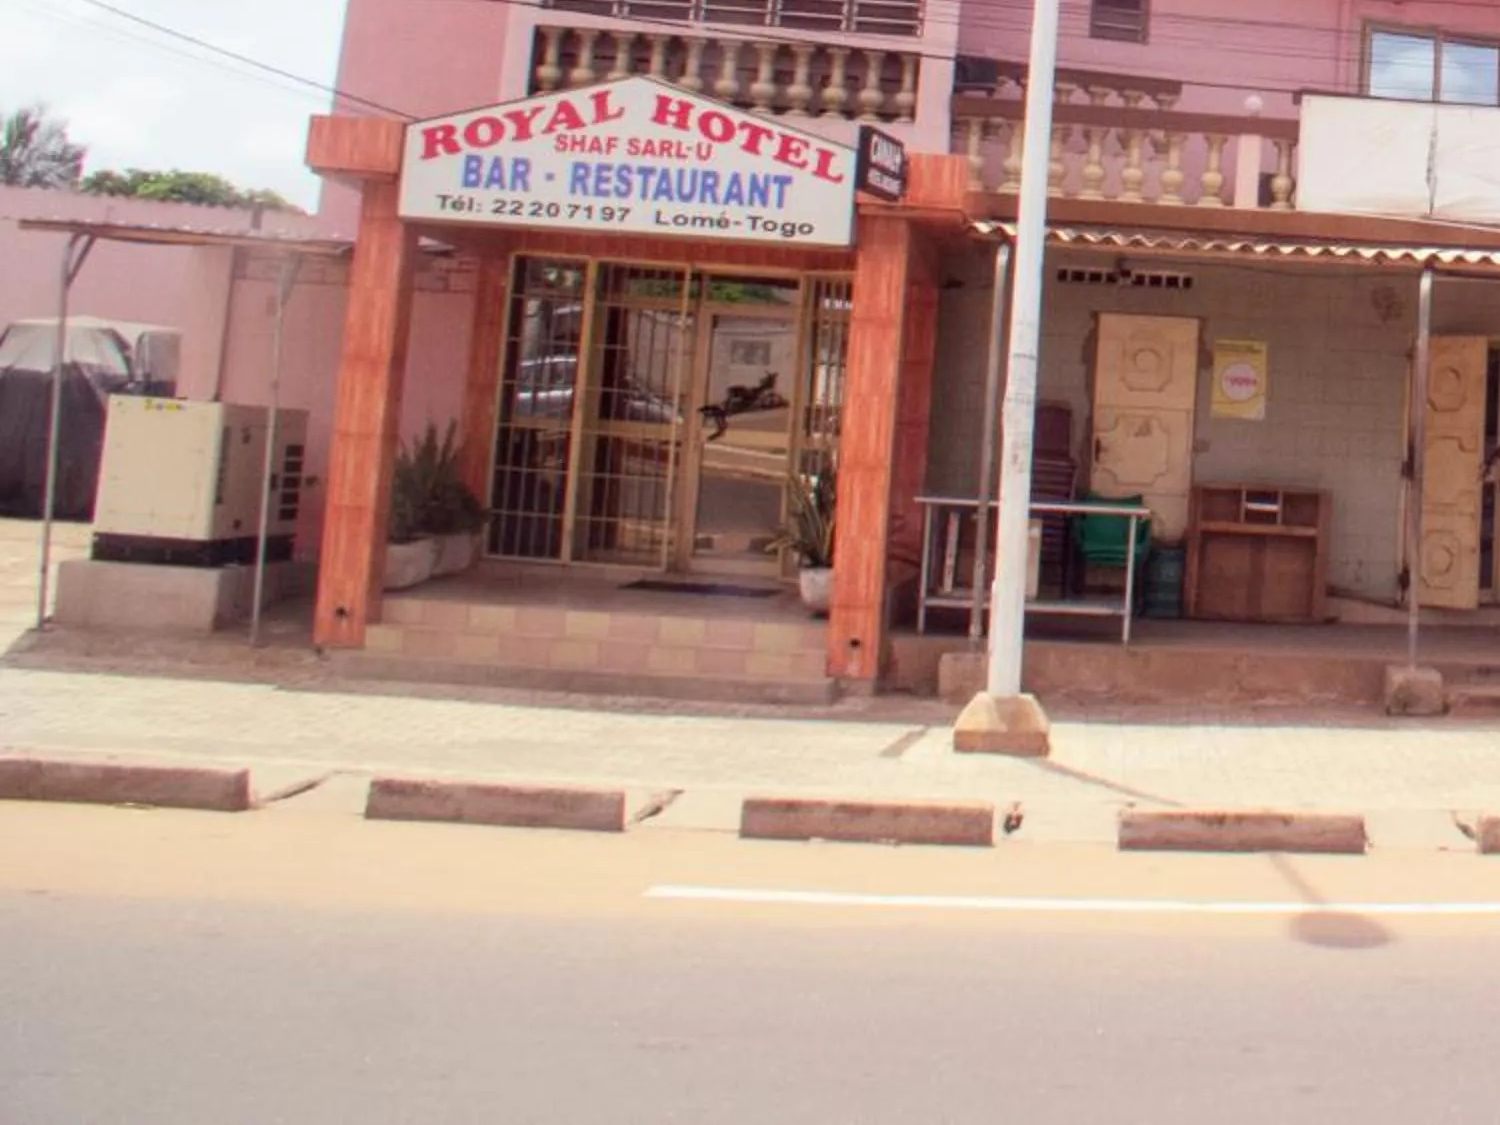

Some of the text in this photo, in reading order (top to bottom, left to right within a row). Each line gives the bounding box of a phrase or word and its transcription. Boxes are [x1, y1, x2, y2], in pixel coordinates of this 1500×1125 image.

[420, 91, 625, 159] ROYAL
[651, 94, 844, 183] HOTEL
[554, 133, 618, 154] SHAF
[462, 154, 531, 192] BAR
[570, 161, 792, 209] RESTAURANT
[436, 194, 482, 213] Tél:
